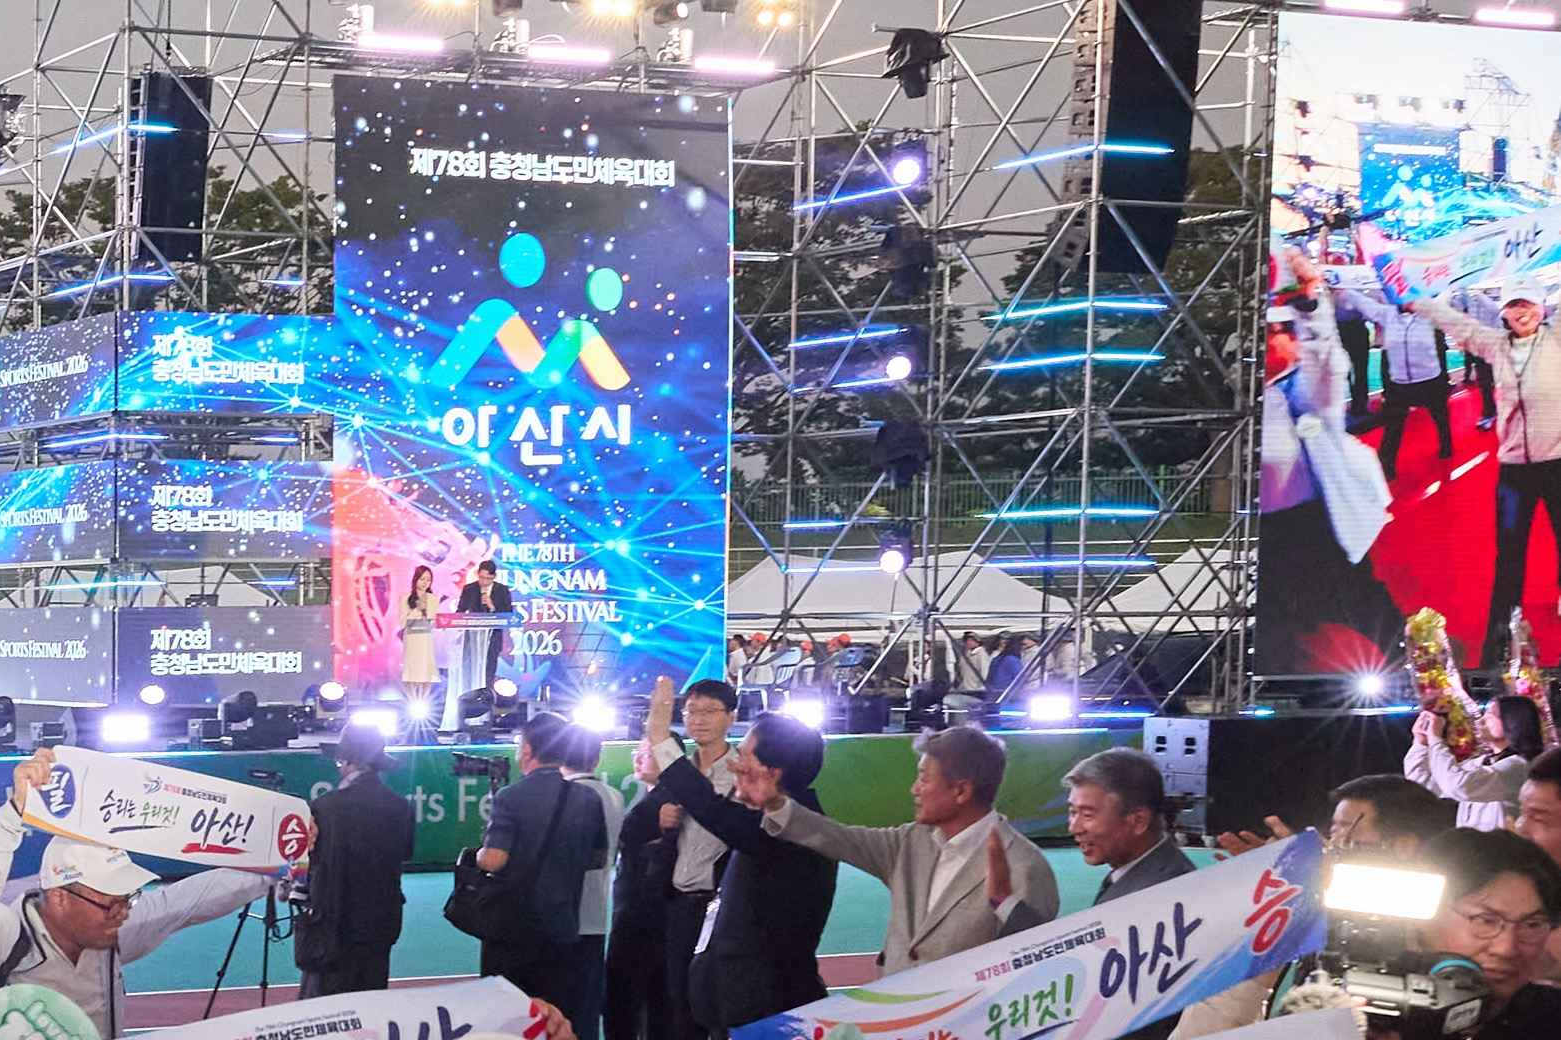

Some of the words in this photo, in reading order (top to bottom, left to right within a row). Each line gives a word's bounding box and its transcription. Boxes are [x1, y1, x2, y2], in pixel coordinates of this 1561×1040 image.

[410, 149, 486, 178] 제78회
[490, 152, 675, 187] 충청남도민체육대회
[152, 335, 212, 357] 제78회
[66, 353, 89, 374] 2026
[152, 360, 304, 384] 충청남도민체육대회
[442, 404, 631, 465] 아산시
[152, 485, 212, 507] 제78회
[152, 510, 303, 532] 충청남도민체육대회
[496, 569, 607, 591] UNGNAM
[531, 599, 623, 623] FESTIVAL
[151, 628, 211, 650] 제78회
[510, 627, 562, 655] 2026
[151, 652, 301, 674] 충청남도민체육대회
[42, 772, 70, 814] 필
[99, 789, 136, 824] 승리는
[140, 801, 180, 825] 우리것!
[191, 807, 254, 847] 아산!
[282, 818, 306, 855] 승
[1098, 901, 1202, 1005] 아산
[1244, 868, 1303, 955] 승
[975, 960, 1011, 982] 제78회
[1011, 927, 1107, 970] 충청남도민체육대회
